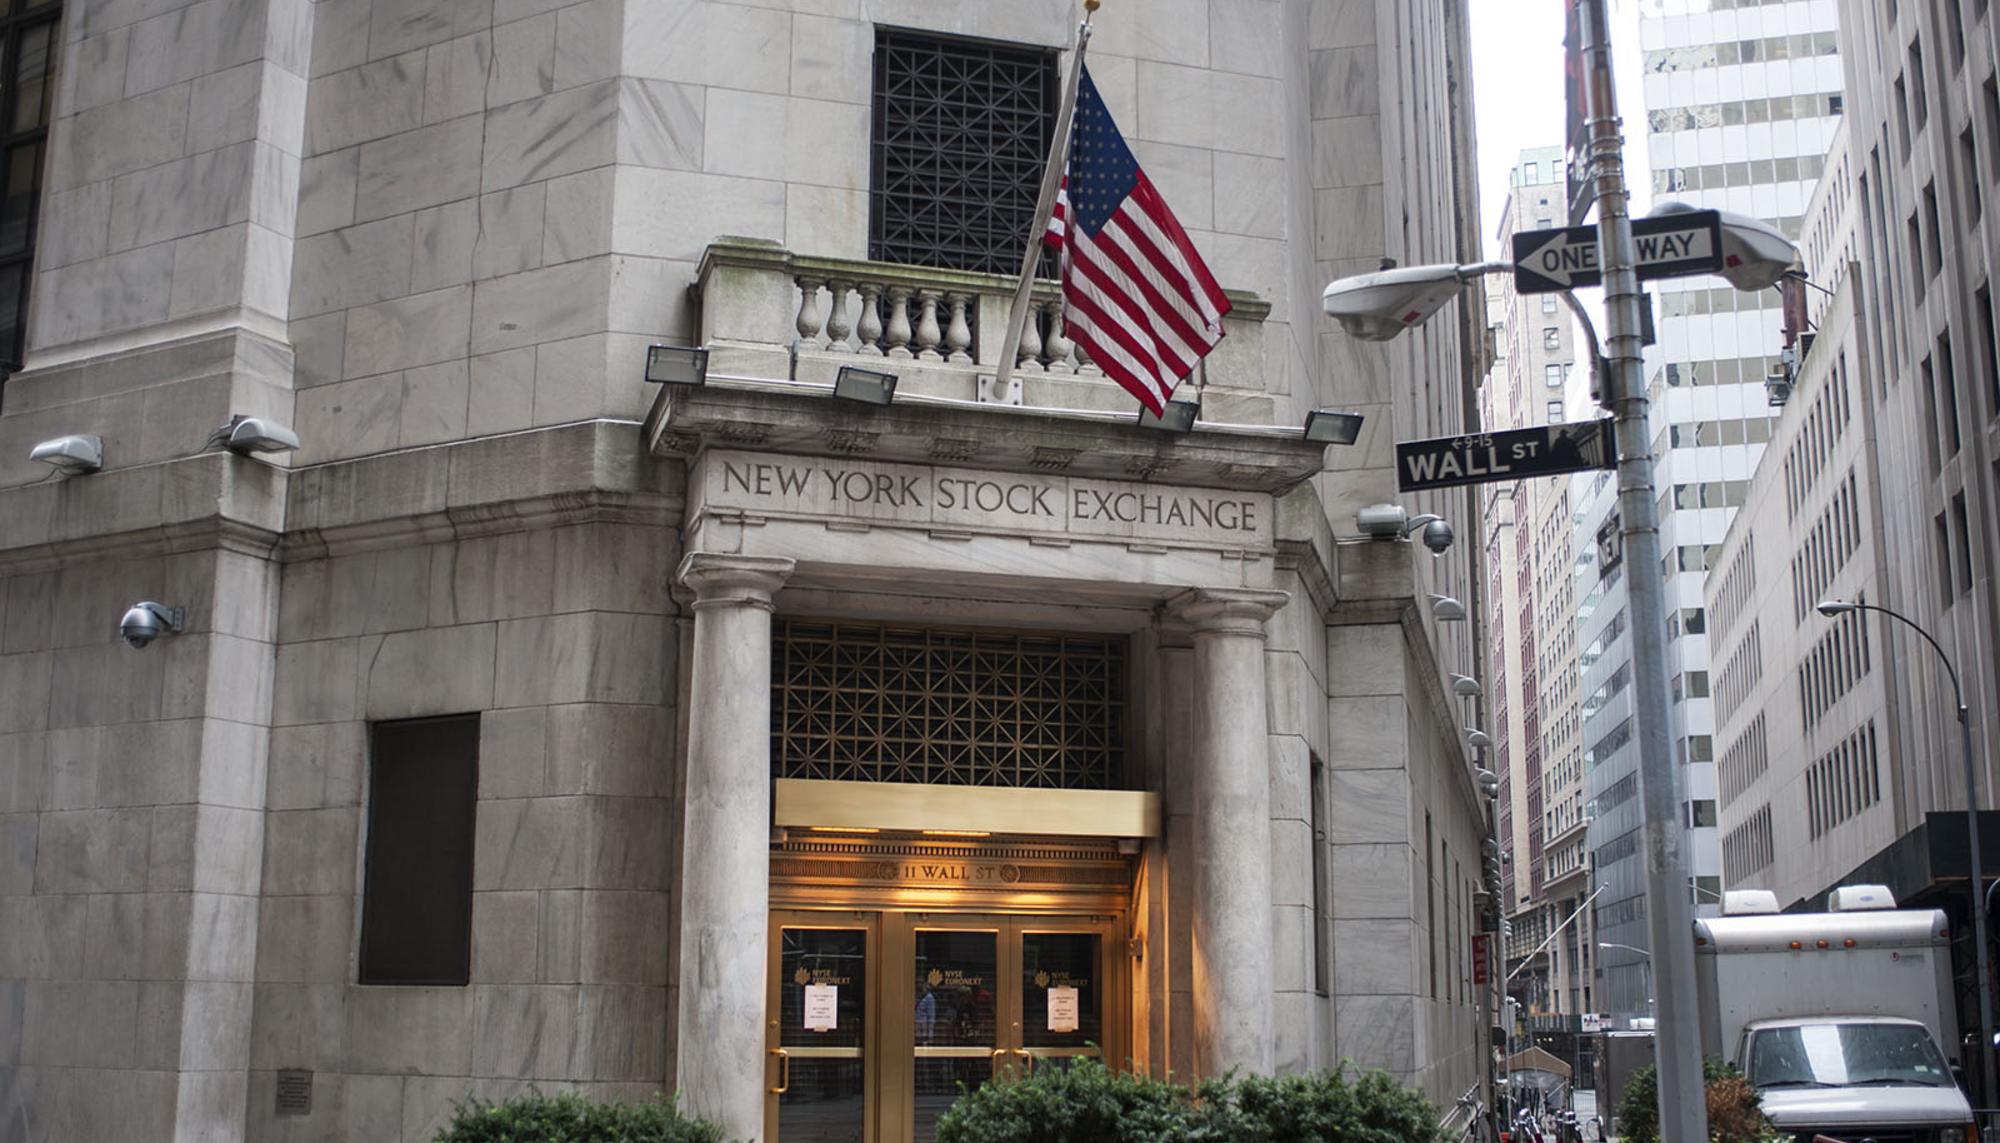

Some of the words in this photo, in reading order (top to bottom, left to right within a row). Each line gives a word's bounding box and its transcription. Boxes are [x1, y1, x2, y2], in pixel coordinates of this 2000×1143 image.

[1542, 244, 1597, 272] ONE
[1636, 232, 1695, 262] WAY
[1464, 433, 1494, 449] 9-15
[1407, 446, 1511, 482] WALL
[1512, 441, 1539, 459] ST
[722, 461, 812, 498] NEW
[822, 469, 924, 508] YORK
[937, 478, 1055, 517] STOCK
[1073, 488, 1257, 532] EXCHANGE
[904, 865, 916, 879] 11
[921, 865, 970, 880] WALL
[975, 866, 995, 880] ST
[944, 970, 962, 978] NYSE
